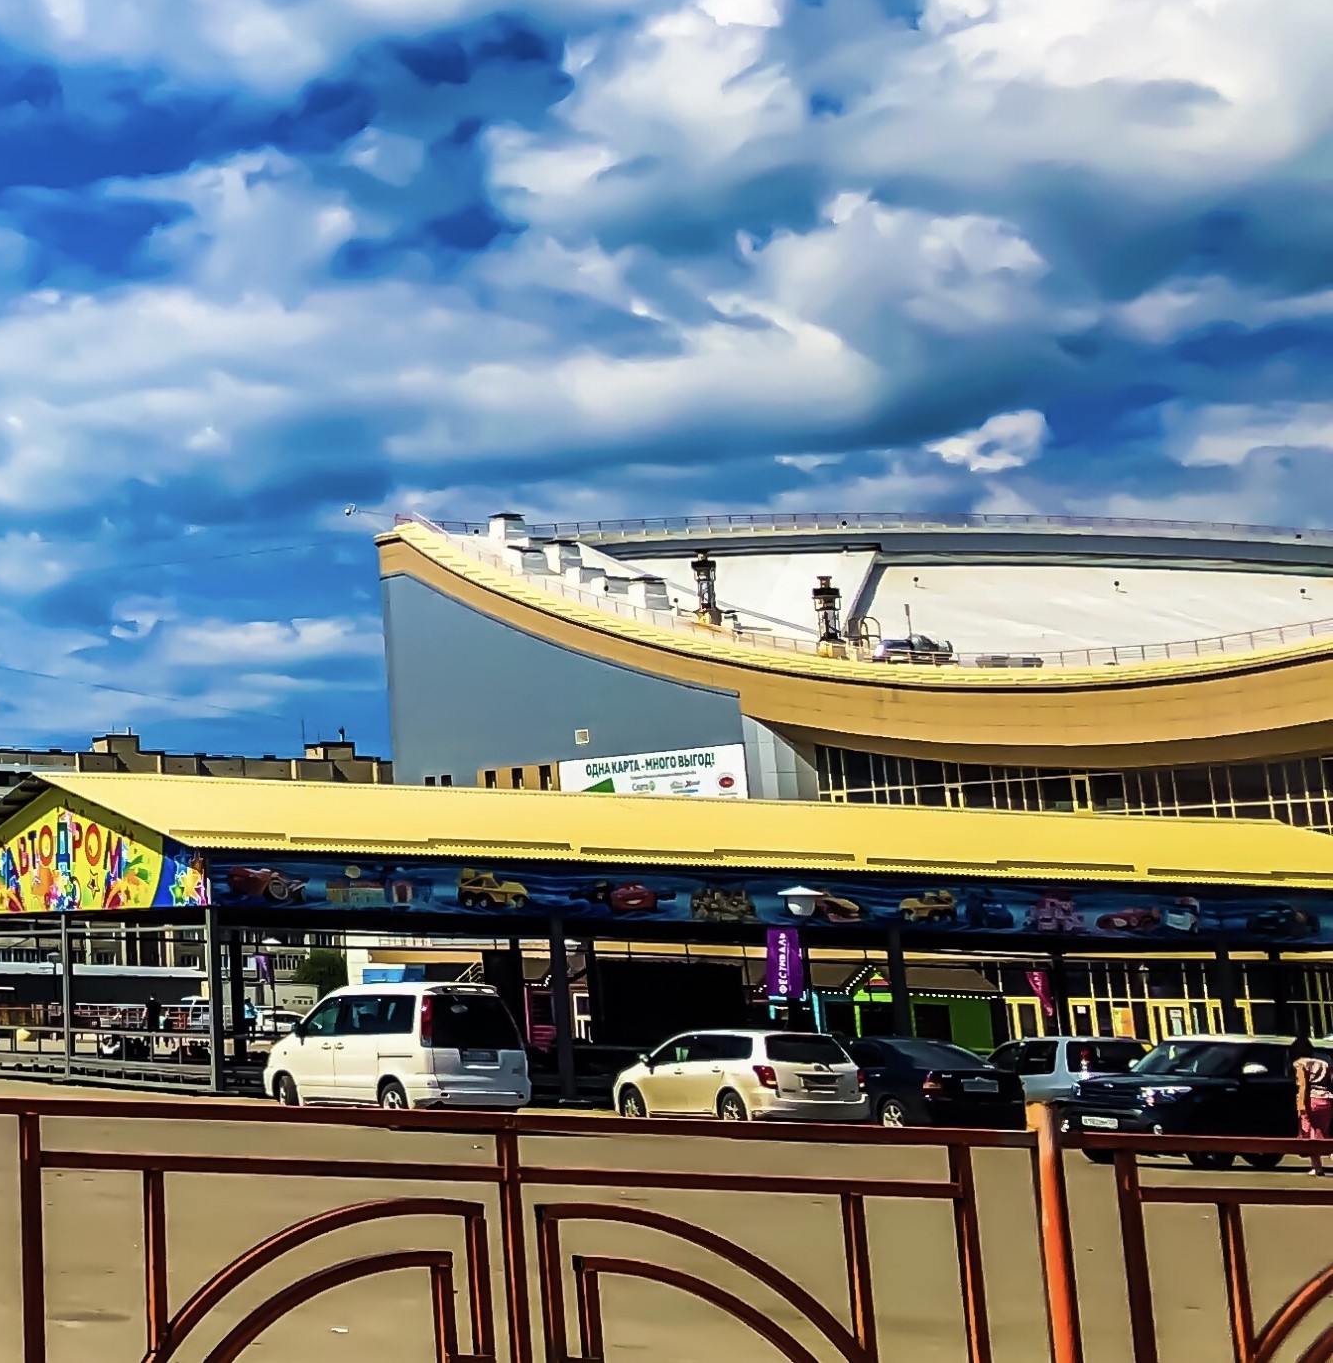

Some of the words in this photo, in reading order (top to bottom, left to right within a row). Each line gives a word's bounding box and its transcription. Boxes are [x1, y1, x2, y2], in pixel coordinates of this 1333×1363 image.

[586, 762, 611, 778] ОДНА
[612, 759, 641, 775] КАРТА
[645, 756, 677, 771] МНОГО
[678, 752, 716, 770] ВЫГОД!
[4, 821, 125, 882] АВТОДРОМ
